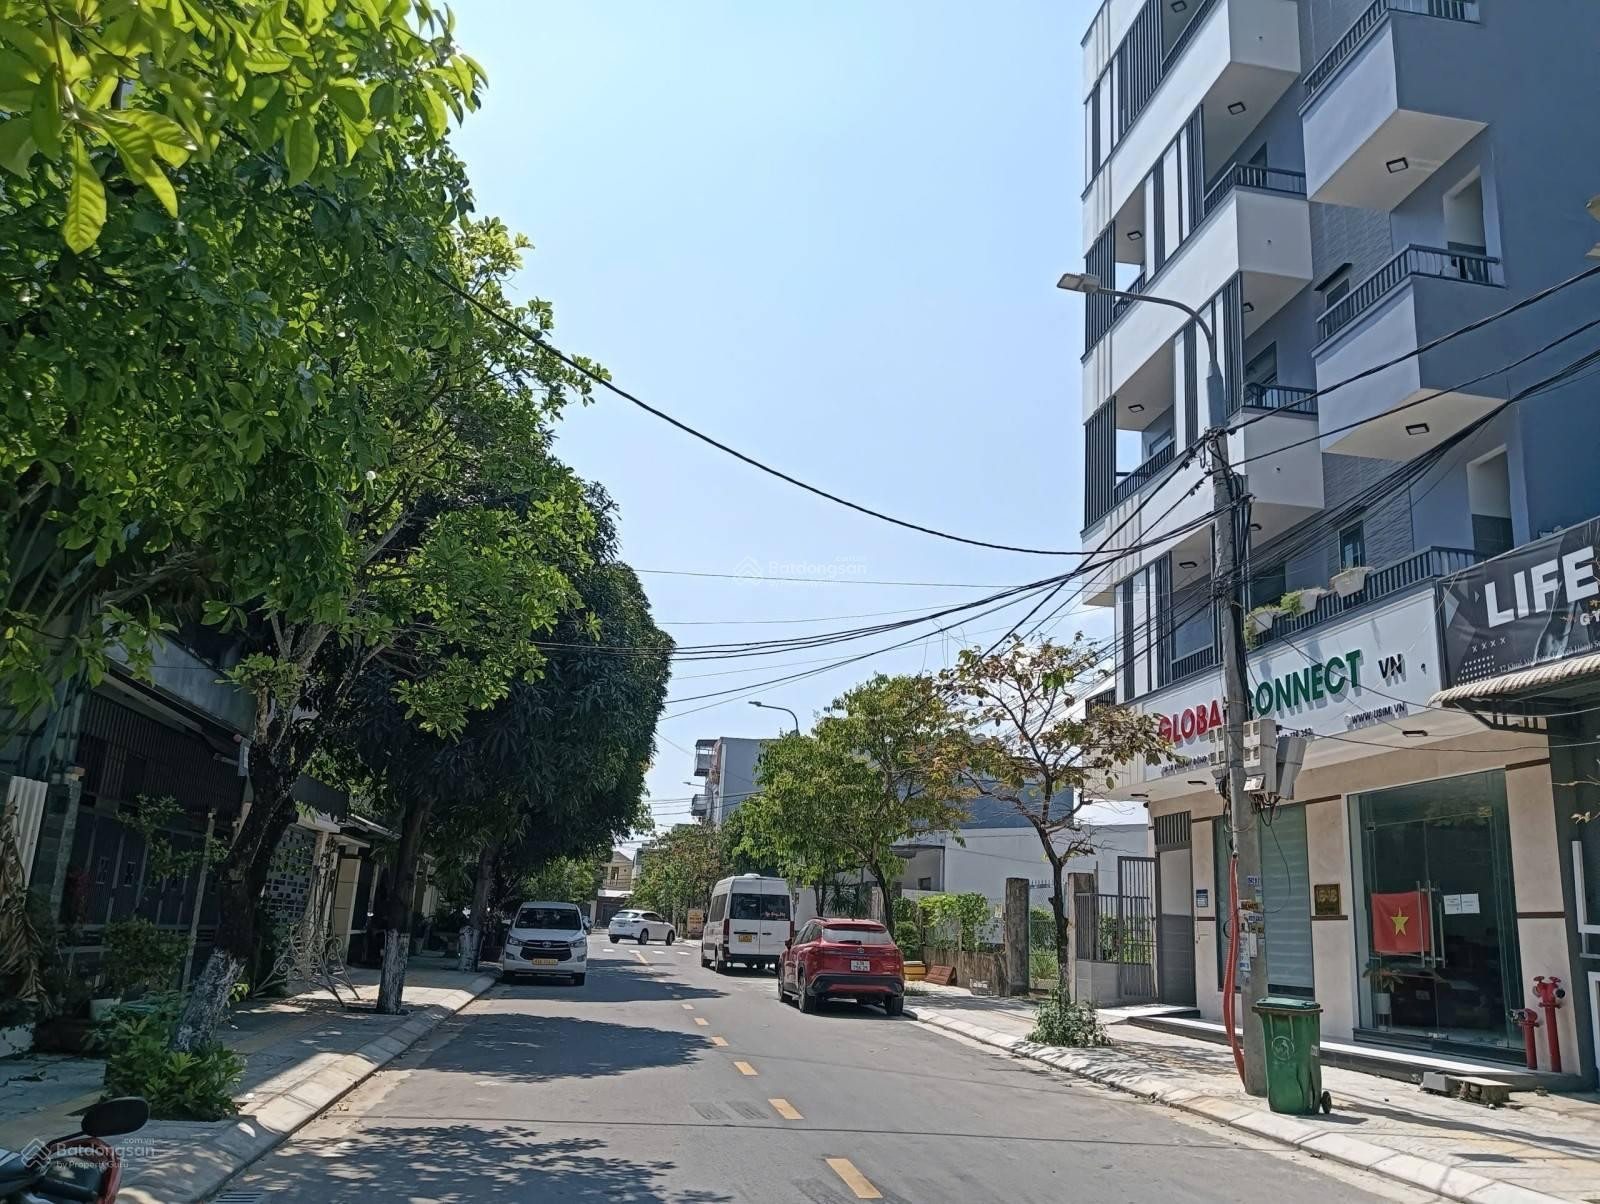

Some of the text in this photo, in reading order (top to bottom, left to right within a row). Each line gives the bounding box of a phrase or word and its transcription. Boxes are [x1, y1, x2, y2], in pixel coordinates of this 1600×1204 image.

[1485, 546, 1600, 628] LIFE
[1158, 649, 1403, 743] GLOBA ONNECT VN
